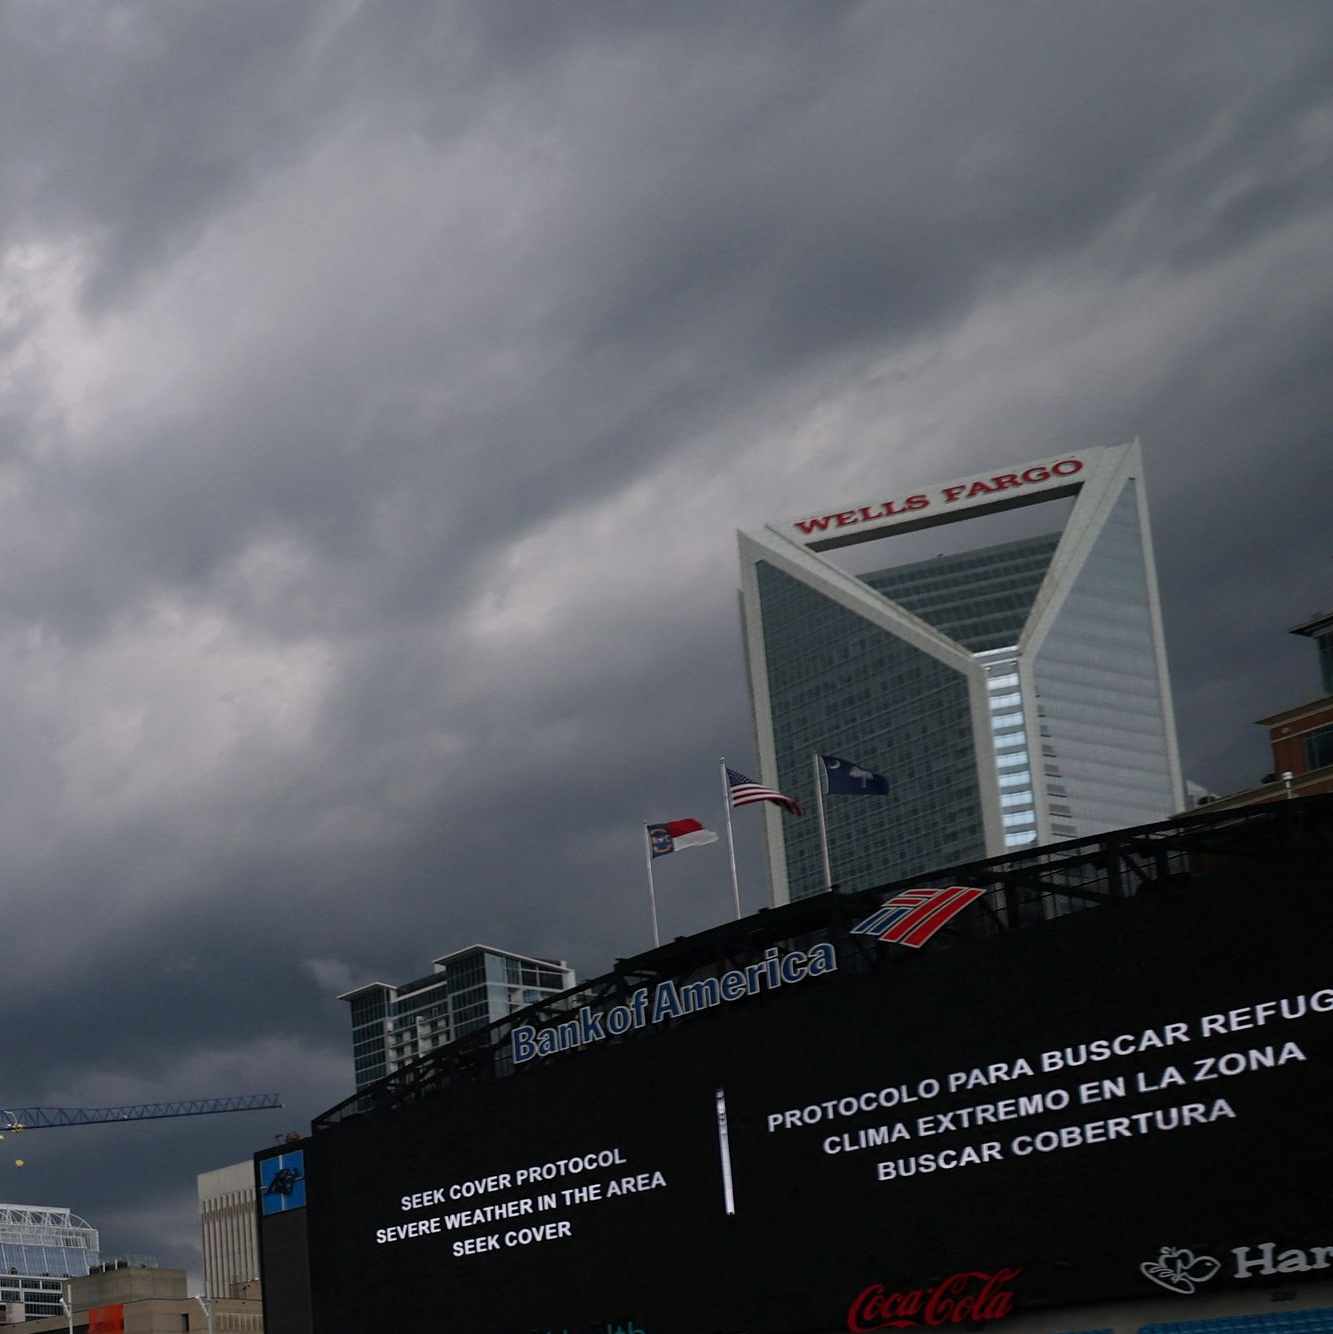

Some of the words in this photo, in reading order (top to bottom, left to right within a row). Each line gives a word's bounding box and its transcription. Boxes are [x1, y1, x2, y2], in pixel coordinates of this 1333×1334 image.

[794, 492, 930, 535] WELLS
[942, 459, 1084, 502] FARGO
[512, 1006, 605, 1064] Bank
[606, 988, 649, 1037] of
[651, 942, 838, 1024] America
[768, 1079, 939, 1132] PROTOCOLO
[949, 1058, 1034, 1092] PARA
[1041, 1023, 1190, 1072] BUSCAR
[824, 1123, 910, 1154] CLIMA
[917, 1089, 1069, 1136] EXTREMO
[1080, 1077, 1125, 1104] EN
[1137, 1066, 1186, 1092] LA
[1194, 1042, 1306, 1081] ZONA
[877, 1142, 1003, 1180] BUSCAR
[1012, 1099, 1236, 1155] COBERTURA
[377, 1218, 441, 1243] SEVERE
[444, 1199, 533, 1229] WEATHER
[538, 1193, 556, 1211] IN
[561, 1184, 602, 1205] THE
[607, 1171, 666, 1197] AREA
[402, 1188, 445, 1210] SEEK
[450, 1174, 511, 1199] COVER
[516, 1149, 626, 1185] PROTOCOL
[453, 1234, 500, 1256] SEEK
[504, 1221, 571, 1246] COVER
[1233, 1241, 1333, 1280] Har
[845, 1266, 1025, 1333] Coca-Cola
